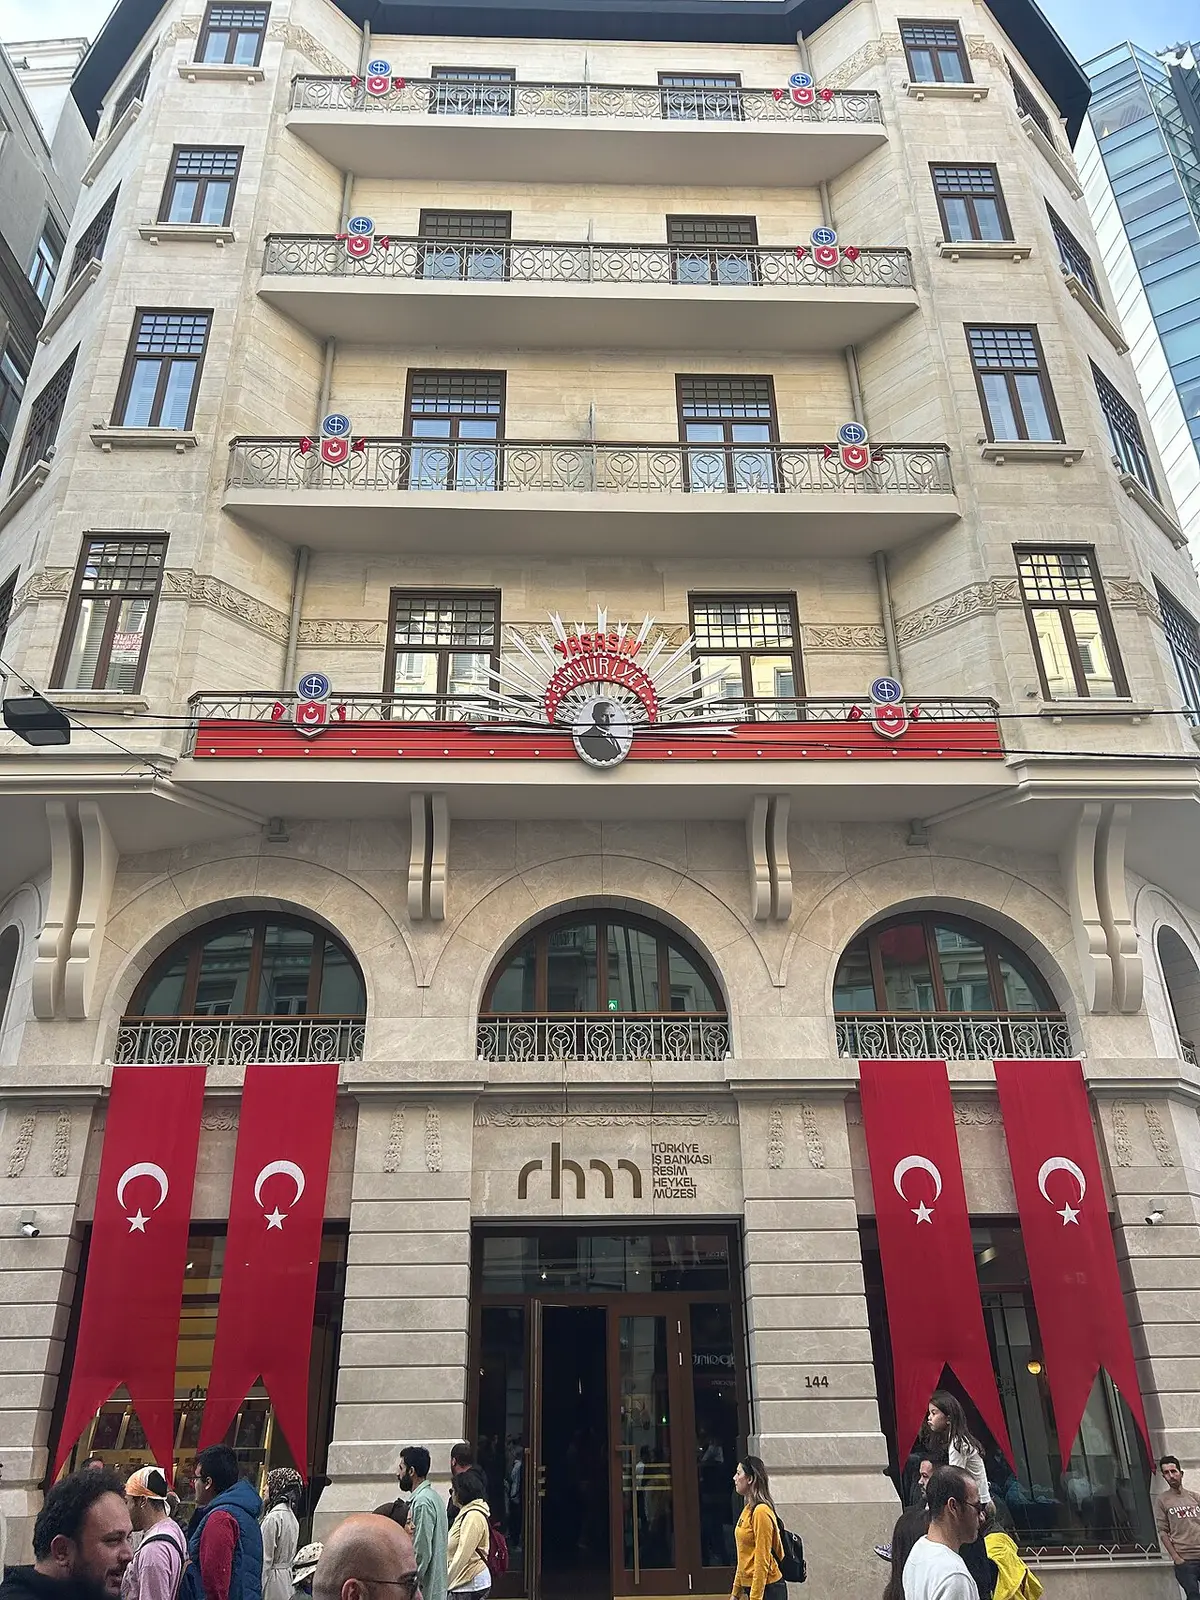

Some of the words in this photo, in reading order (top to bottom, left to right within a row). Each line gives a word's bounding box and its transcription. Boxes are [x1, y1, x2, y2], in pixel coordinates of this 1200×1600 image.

[552, 657, 650, 693] CUMHURİYET
[651, 1141, 699, 1153] TÜRKİYE
[651, 1153, 662, 1166] İŞ
[664, 1154, 712, 1165] BANKASI
[518, 1142, 642, 1200] rhm
[652, 1164, 688, 1176] RESİM
[652, 1177, 697, 1188] HEYKEL
[653, 1187, 697, 1199] MÜZESİ
[804, 1375, 829, 1388] 144
